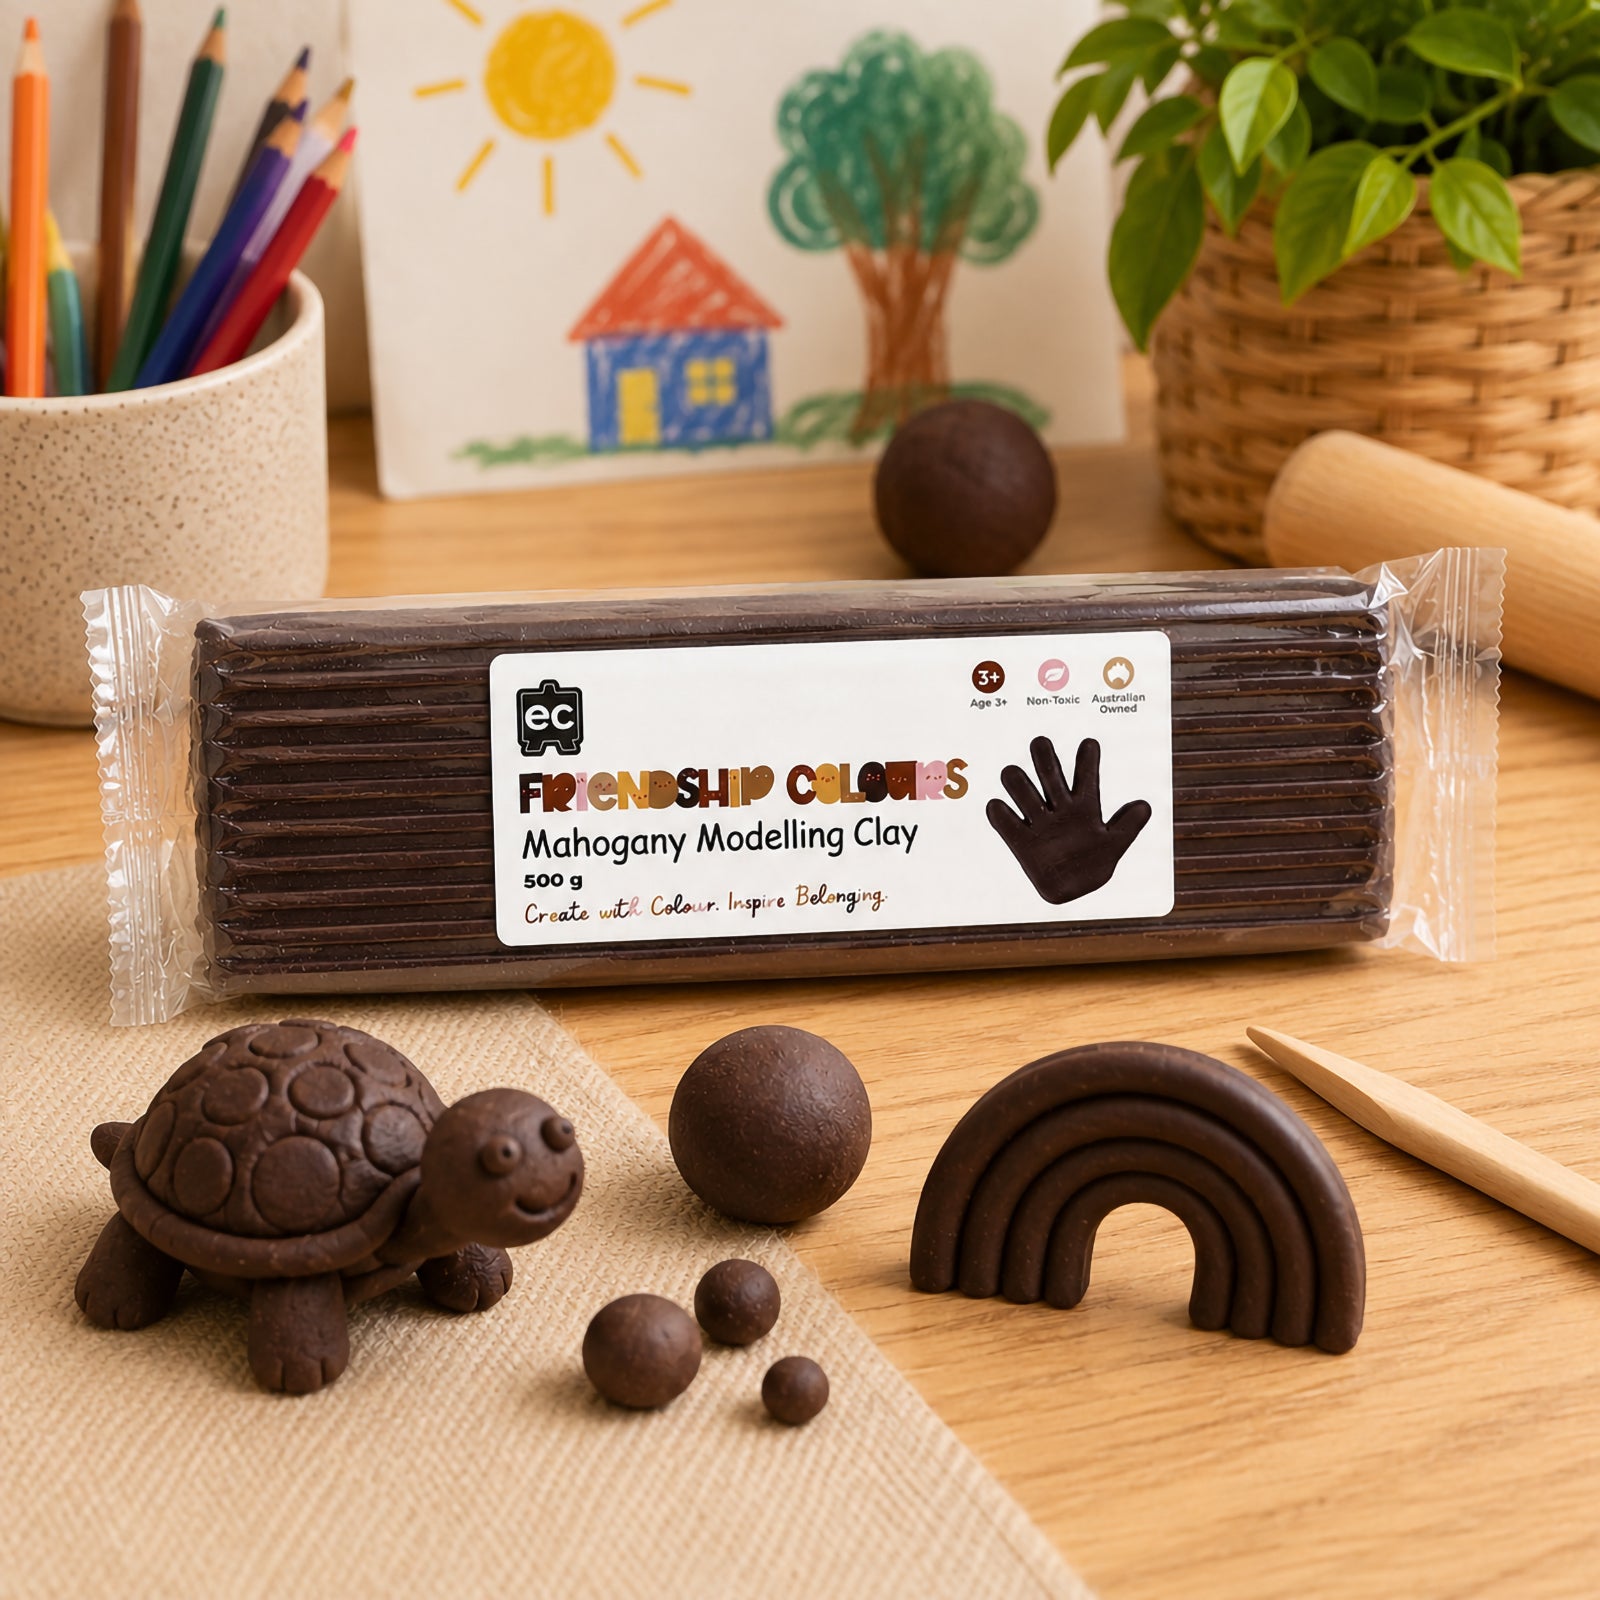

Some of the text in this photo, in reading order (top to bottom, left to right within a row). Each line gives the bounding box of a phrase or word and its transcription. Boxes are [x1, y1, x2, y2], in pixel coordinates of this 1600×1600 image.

[978, 670, 1000, 686] 3+
[970, 697, 1008, 710] Age 3+
[1026, 694, 1081, 706] Non-Toxic
[1091, 692, 1146, 704] Australian
[524, 703, 575, 731] ec
[1099, 703, 1138, 714] Owned
[786, 758, 969, 805] COLOURS
[522, 815, 919, 866] Mahogany Modelling Clay
[523, 872, 583, 891] 500 g
[525, 883, 889, 925] Create with Colour. Inspire Belonging.
